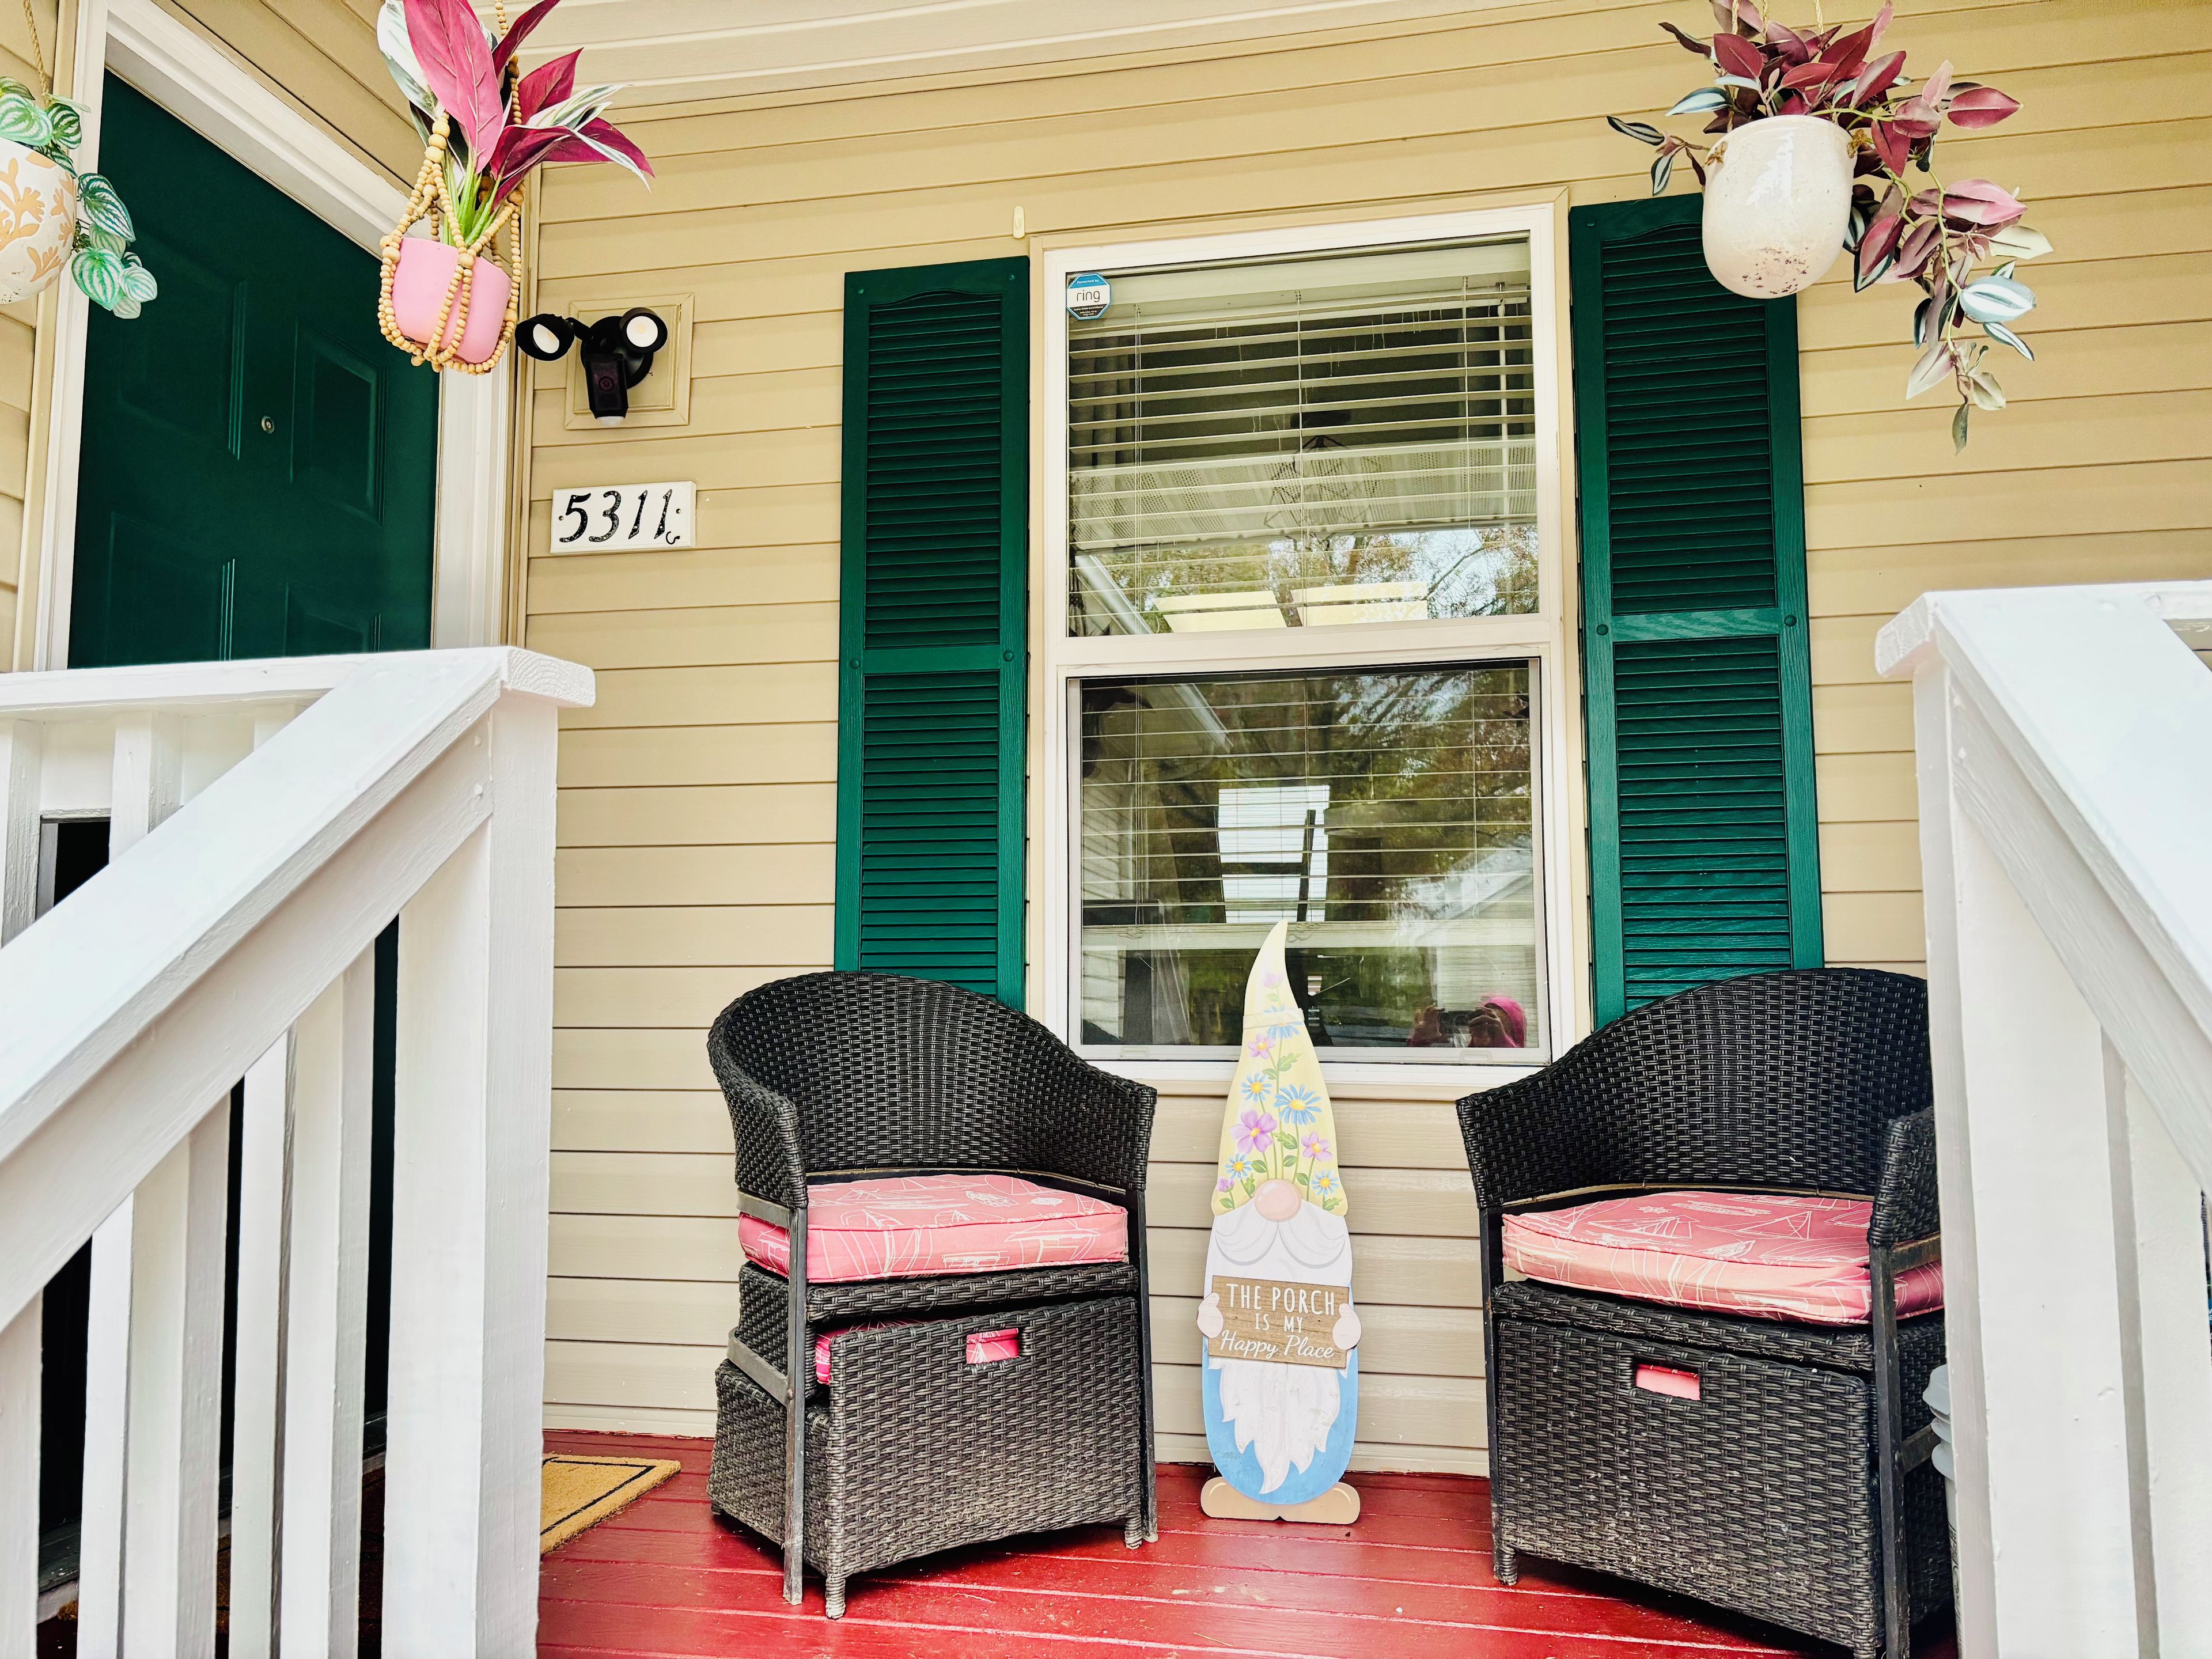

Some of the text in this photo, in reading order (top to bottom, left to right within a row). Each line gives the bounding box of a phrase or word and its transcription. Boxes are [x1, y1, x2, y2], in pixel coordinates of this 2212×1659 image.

[1077, 290, 1100, 302] ring
[559, 488, 673, 543] 5311
[1226, 1283, 1335, 1316] THE PORCH
[1255, 1313, 1303, 1333] IS MY
[1220, 1330, 1335, 1359] Happy Place
